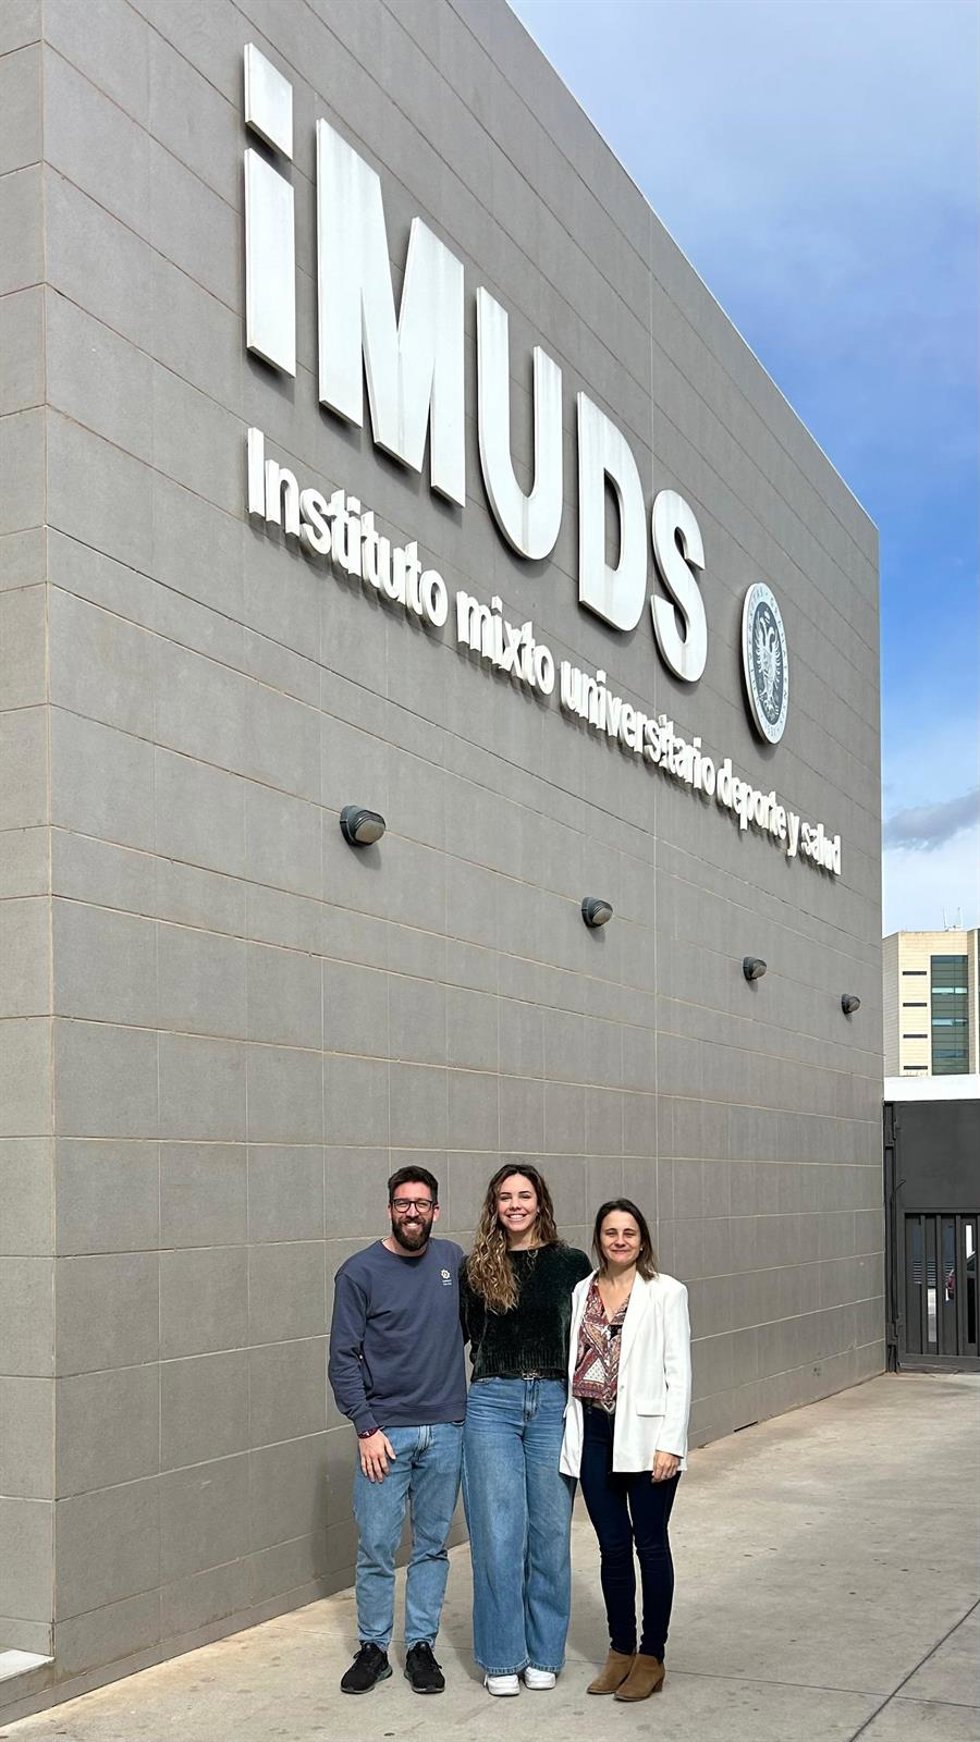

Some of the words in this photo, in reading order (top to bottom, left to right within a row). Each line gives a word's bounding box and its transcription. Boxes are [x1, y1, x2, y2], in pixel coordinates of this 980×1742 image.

[243, 42, 707, 684] iMUDS
[247, 426, 449, 627] Instituto
[456, 590, 555, 696] mixto
[560, 660, 715, 796] universitario
[717, 758, 787, 840] deporte
[786, 811, 800, 857] y
[801, 822, 842, 876] salud
